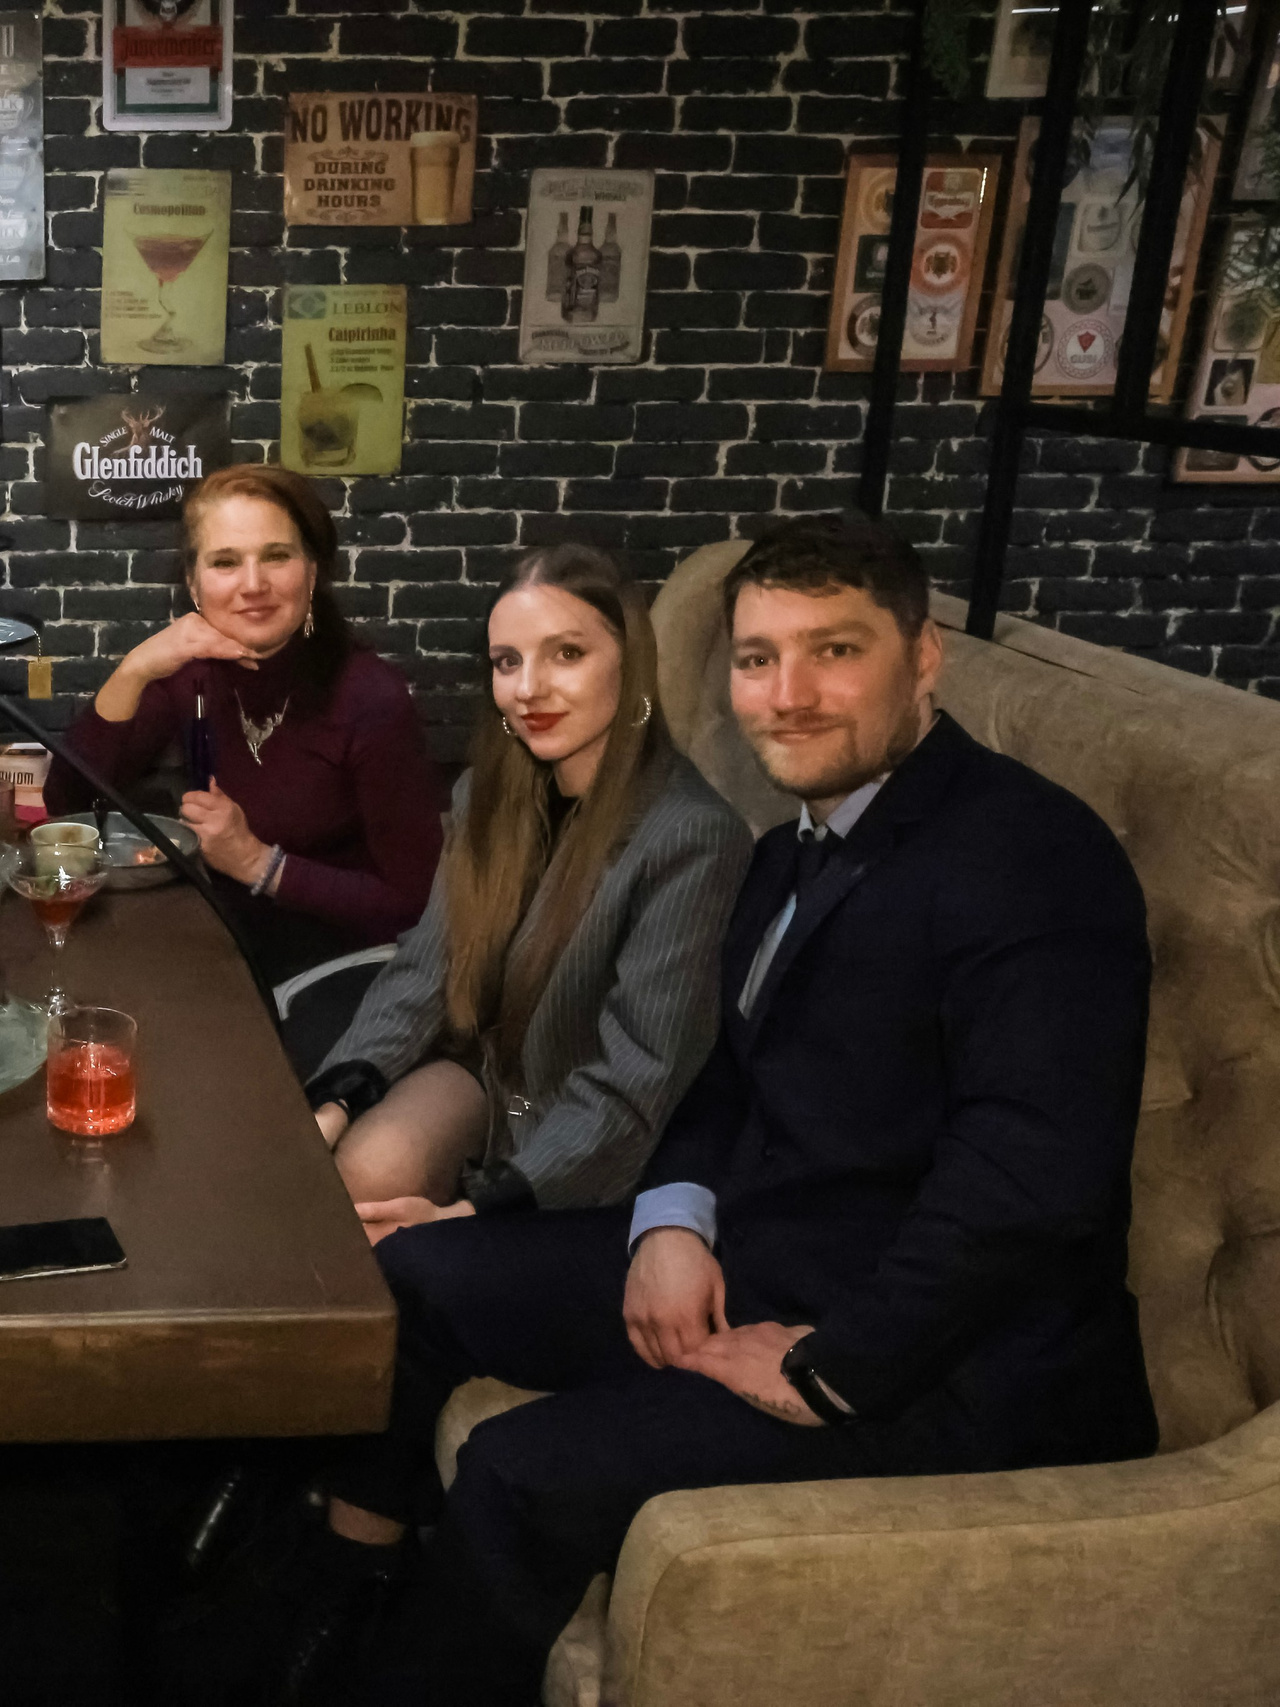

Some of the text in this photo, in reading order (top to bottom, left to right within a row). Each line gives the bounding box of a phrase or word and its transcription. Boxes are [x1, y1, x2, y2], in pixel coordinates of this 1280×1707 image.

[290, 98, 471, 143] NO WORKING
[314, 162, 386, 175] DURING
[303, 178, 396, 191] DRINKING
[317, 195, 381, 208] HOURS
[99, 426, 176, 448] SINGLE MALT
[72, 441, 203, 480] Glenfiddich
[88, 480, 134, 508] Scotch
